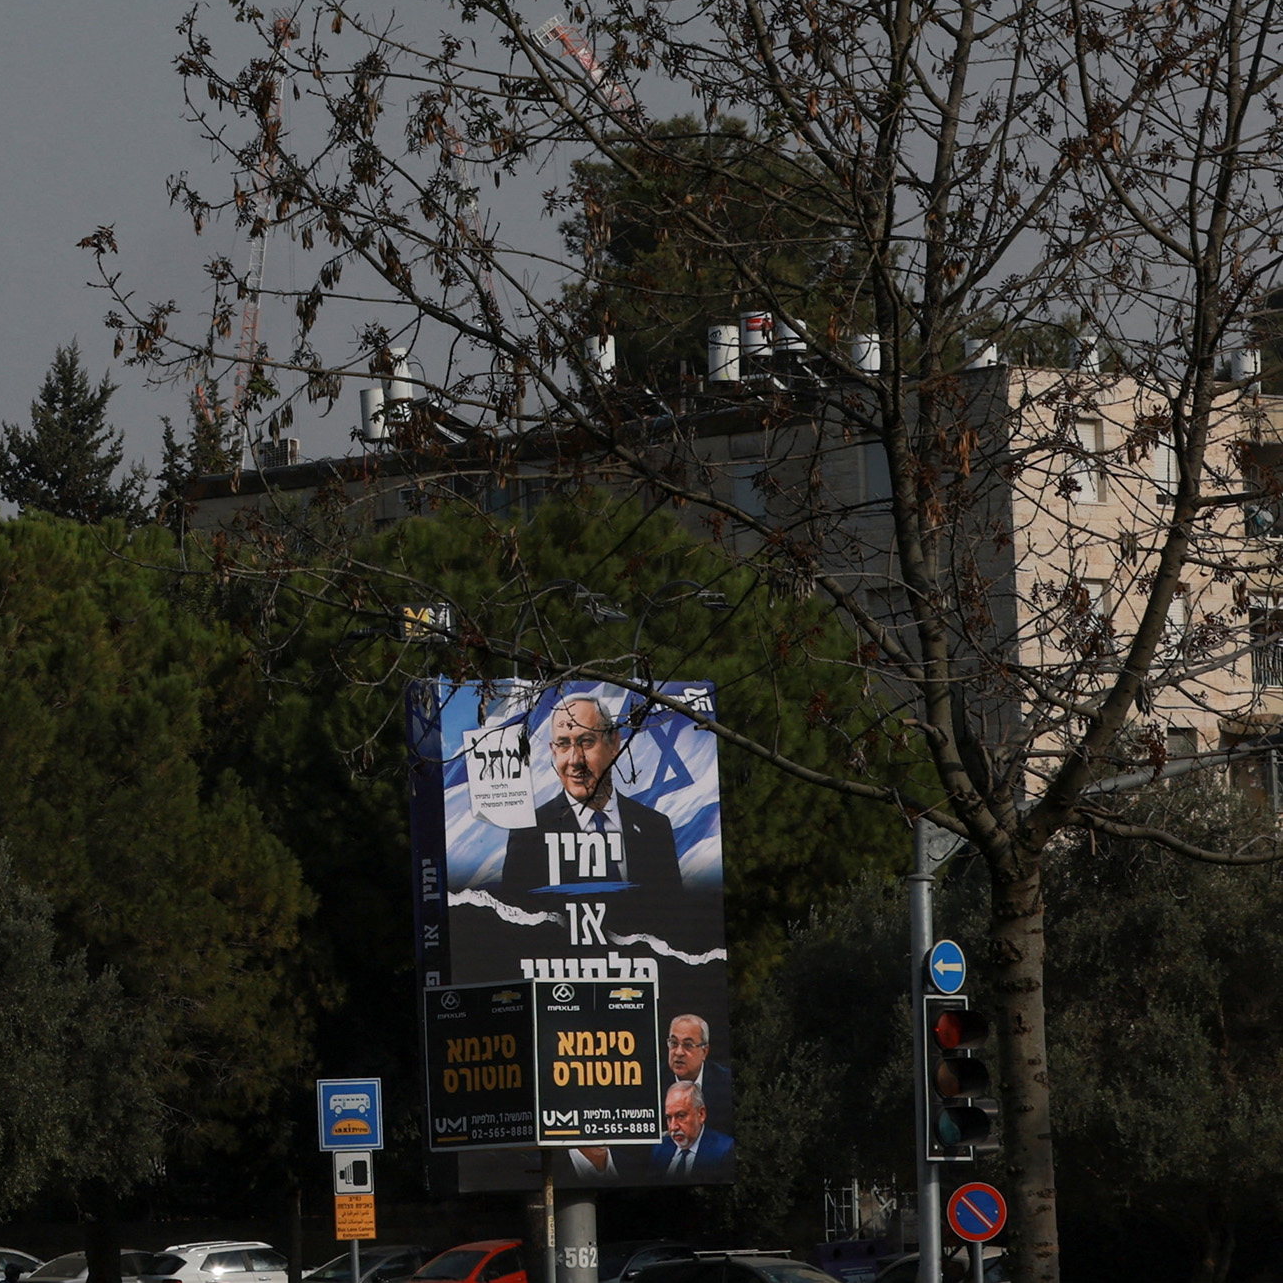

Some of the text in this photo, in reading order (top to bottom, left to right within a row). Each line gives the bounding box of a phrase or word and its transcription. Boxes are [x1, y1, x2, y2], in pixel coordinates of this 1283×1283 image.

[471, 737, 522, 781] מחל
[544, 831, 623, 886] ימין
[421, 858, 441, 949] ימין או
[564, 902, 608, 946] או
[491, 1005, 524, 1014] CHEVROLET
[446, 1033, 517, 1064] סיגמא
[556, 1030, 636, 1057] סיגמא
[443, 1063, 523, 1094] מוטורס
[552, 1061, 643, 1087] מוטורס
[435, 1116, 467, 1133] UMI
[542, 1110, 579, 1127] UMI
[583, 1108, 611, 1119] תלפיות
[471, 1125, 533, 1140] 02-565-8888
[584, 1122, 656, 1134] 02-565-8888
[563, 1247, 598, 1268] 562
